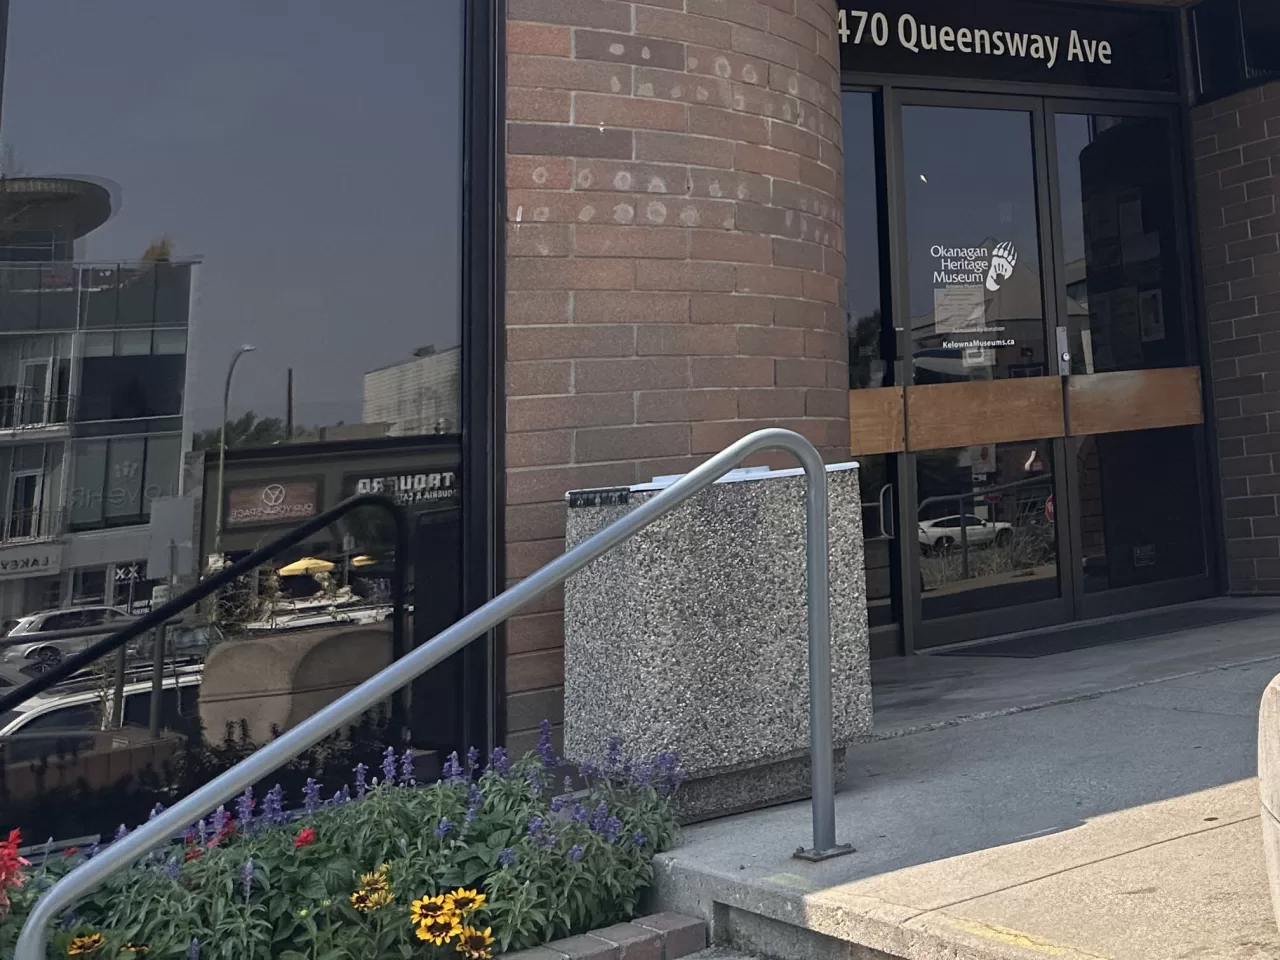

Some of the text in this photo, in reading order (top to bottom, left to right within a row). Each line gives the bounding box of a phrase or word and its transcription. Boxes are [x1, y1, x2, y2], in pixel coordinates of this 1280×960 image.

[837, 9, 1113, 69] 470 Queensway Ave
[930, 244, 988, 260] Okanagan
[941, 258, 989, 273] Heritage
[932, 271, 984, 283] Museum
[942, 339, 1015, 349] KelownaMuseums.ca
